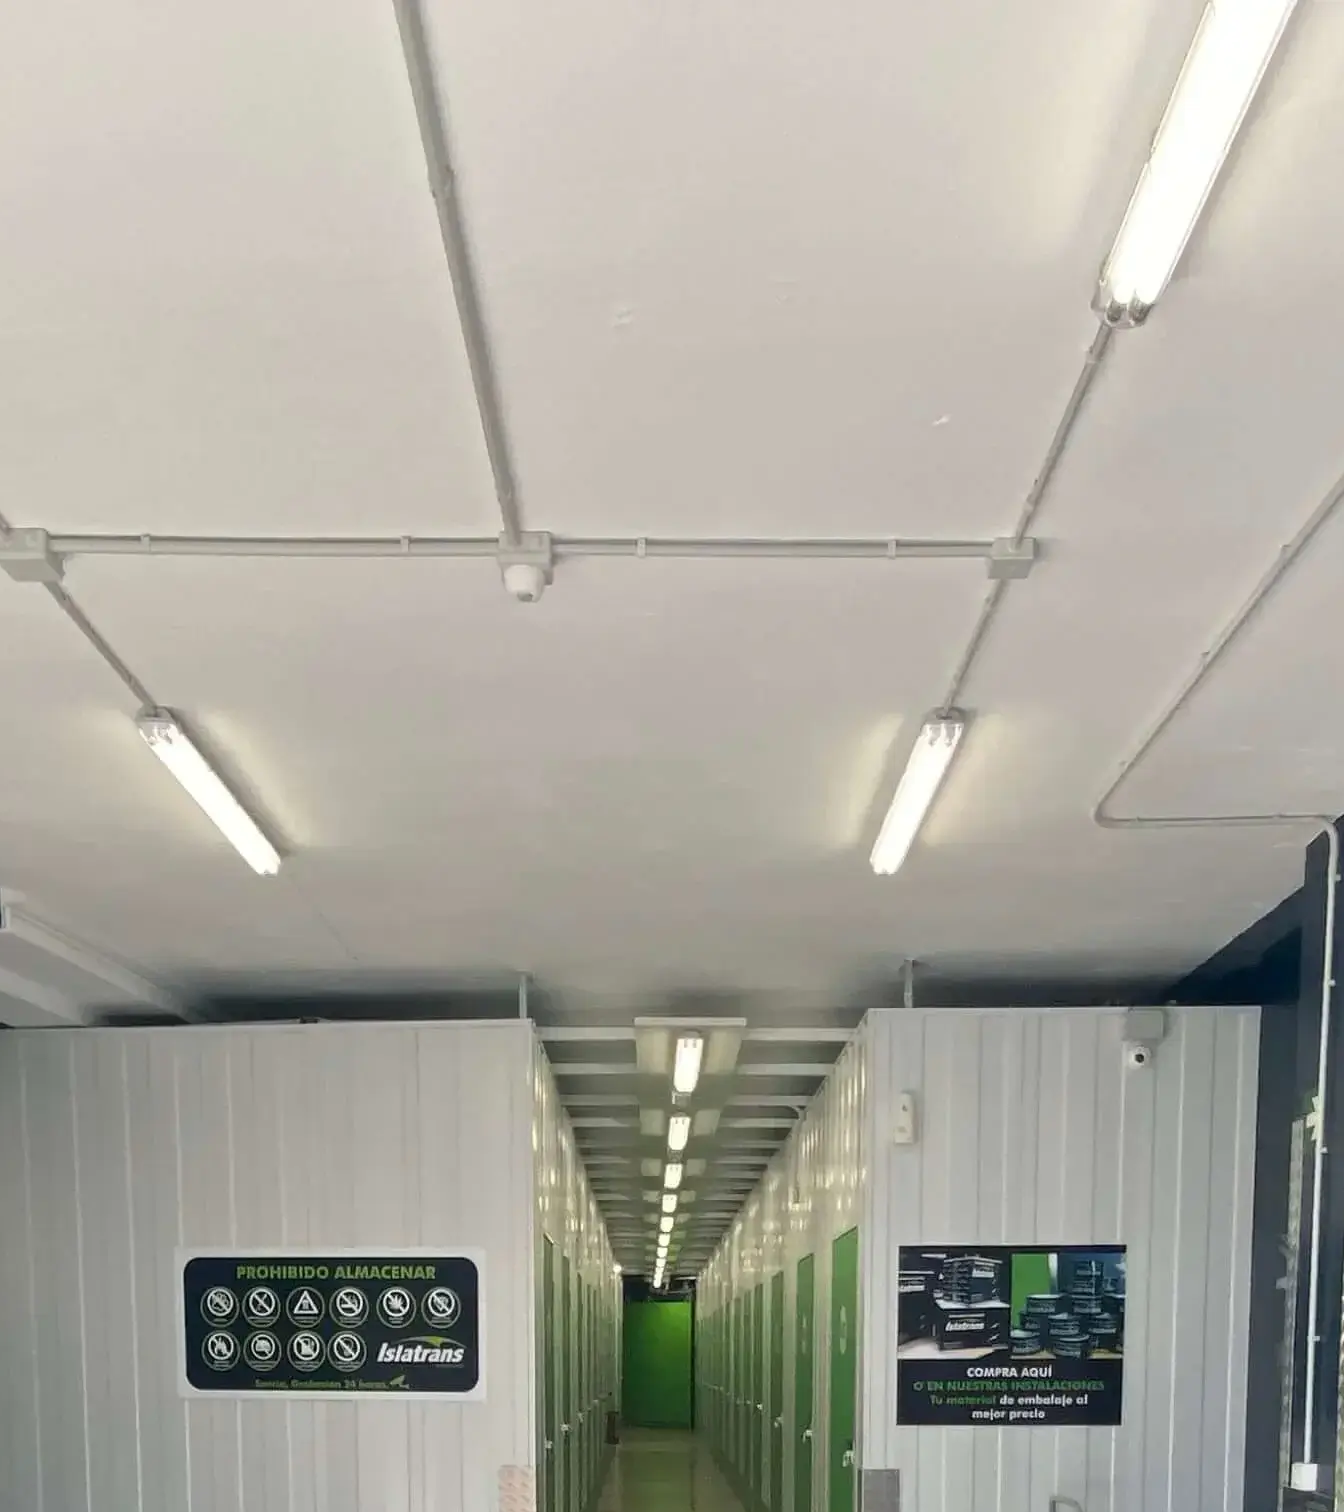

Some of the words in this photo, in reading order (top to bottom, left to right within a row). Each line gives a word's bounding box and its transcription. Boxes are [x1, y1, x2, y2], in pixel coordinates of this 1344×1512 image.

[236, 1265, 329, 1280] PROHIBIDO
[334, 1265, 436, 1280] ALMACENAR
[377, 1342, 464, 1363] Islatrans
[966, 1366, 1018, 1378] COMPRA
[913, 1381, 924, 1391] O
[927, 1381, 944, 1391] EN
[947, 1381, 1007, 1391] NUESTRAS
[946, 1394, 996, 1405] material
[999, 1394, 1015, 1405] de
[1017, 1394, 1073, 1407] embalaje
[1075, 1394, 1089, 1405] al
[971, 1408, 1006, 1421] mejor
[1008, 1408, 1045, 1420] precio
